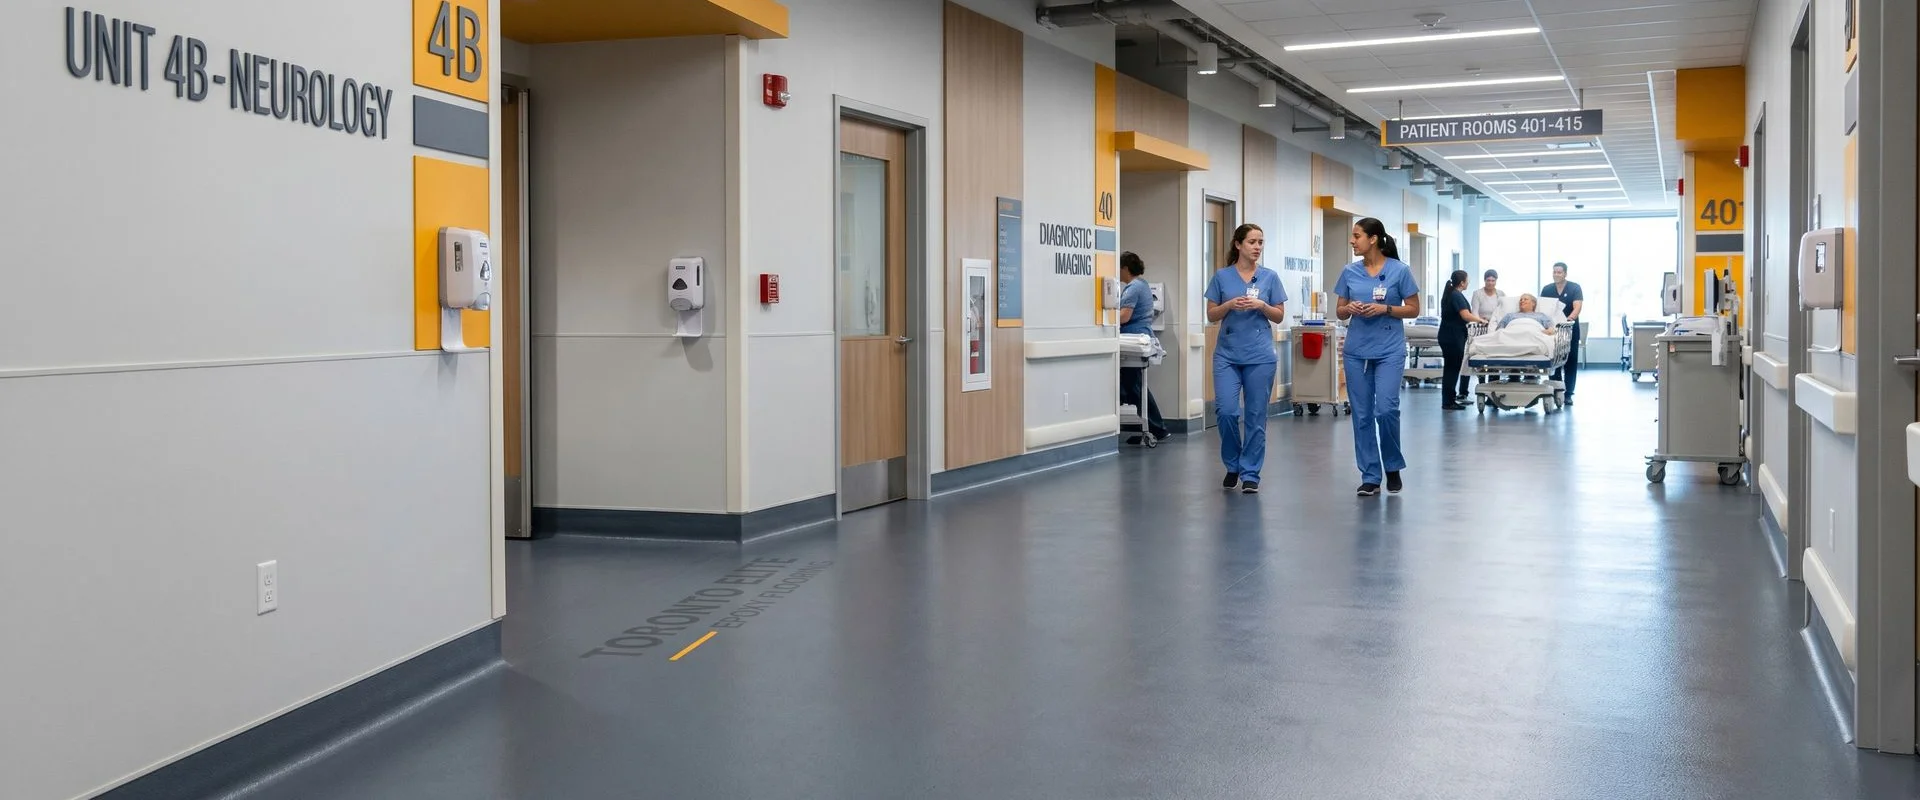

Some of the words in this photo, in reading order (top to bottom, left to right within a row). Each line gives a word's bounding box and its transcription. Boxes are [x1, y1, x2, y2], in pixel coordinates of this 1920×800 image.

[66, 6, 156, 91] UNIT
[428, 1, 482, 83] 4B
[1400, 122, 1458, 139] PATIENT
[1462, 119, 1517, 136] ROOMS
[1520, 116, 1583, 133] 401-415
[1039, 222, 1092, 249] DIAGNOSTIC
[1700, 198, 1744, 226] 40
[1055, 252, 1092, 276] IMAGING
[578, 587, 744, 659] TORONTO
[713, 557, 799, 585] ELITE
[709, 599, 776, 629] EPOXY
[757, 560, 835, 599] FLOORING
